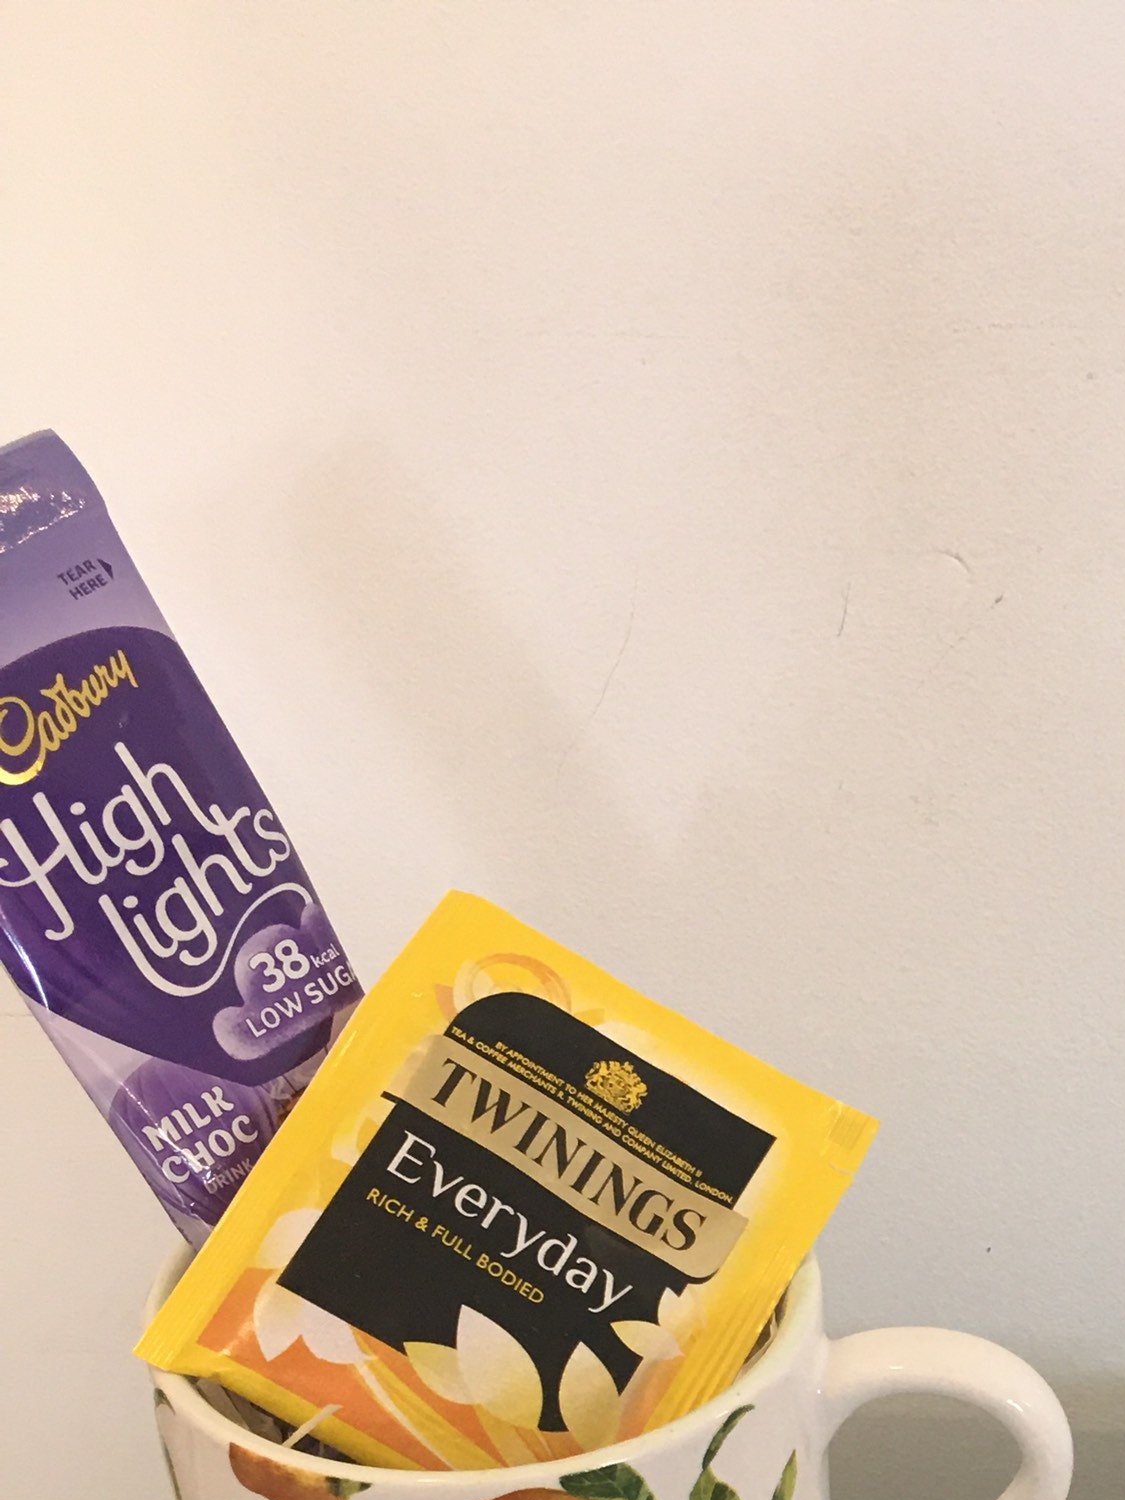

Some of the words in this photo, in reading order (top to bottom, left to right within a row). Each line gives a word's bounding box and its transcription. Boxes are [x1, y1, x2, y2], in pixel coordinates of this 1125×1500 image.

[58, 558, 97, 586] TEAR
[69, 573, 107, 600] HERE
[0, 649, 138, 786] Cadbury
[249, 938, 310, 992] 38
[309, 942, 340, 968] kcal
[245, 991, 303, 1038] LOW
[475, 1041, 508, 1064] COFFEE
[507, 1060, 557, 1094] MERCHANTS
[621, 1135, 662, 1164] COMPANY
[506, 1049, 565, 1086] APPOINTMENT
[564, 1083, 577, 1094] TO
[142, 1086, 234, 1152] MILK
[161, 1115, 259, 1184] CHOC
[430, 1058, 708, 1252] TWININGS
[366, 1187, 414, 1223] RICH
[414, 1216, 428, 1232] &
[431, 1224, 473, 1261] FULL
[475, 1252, 546, 1304] BODIED
[386, 1130, 634, 1314] Everyday
